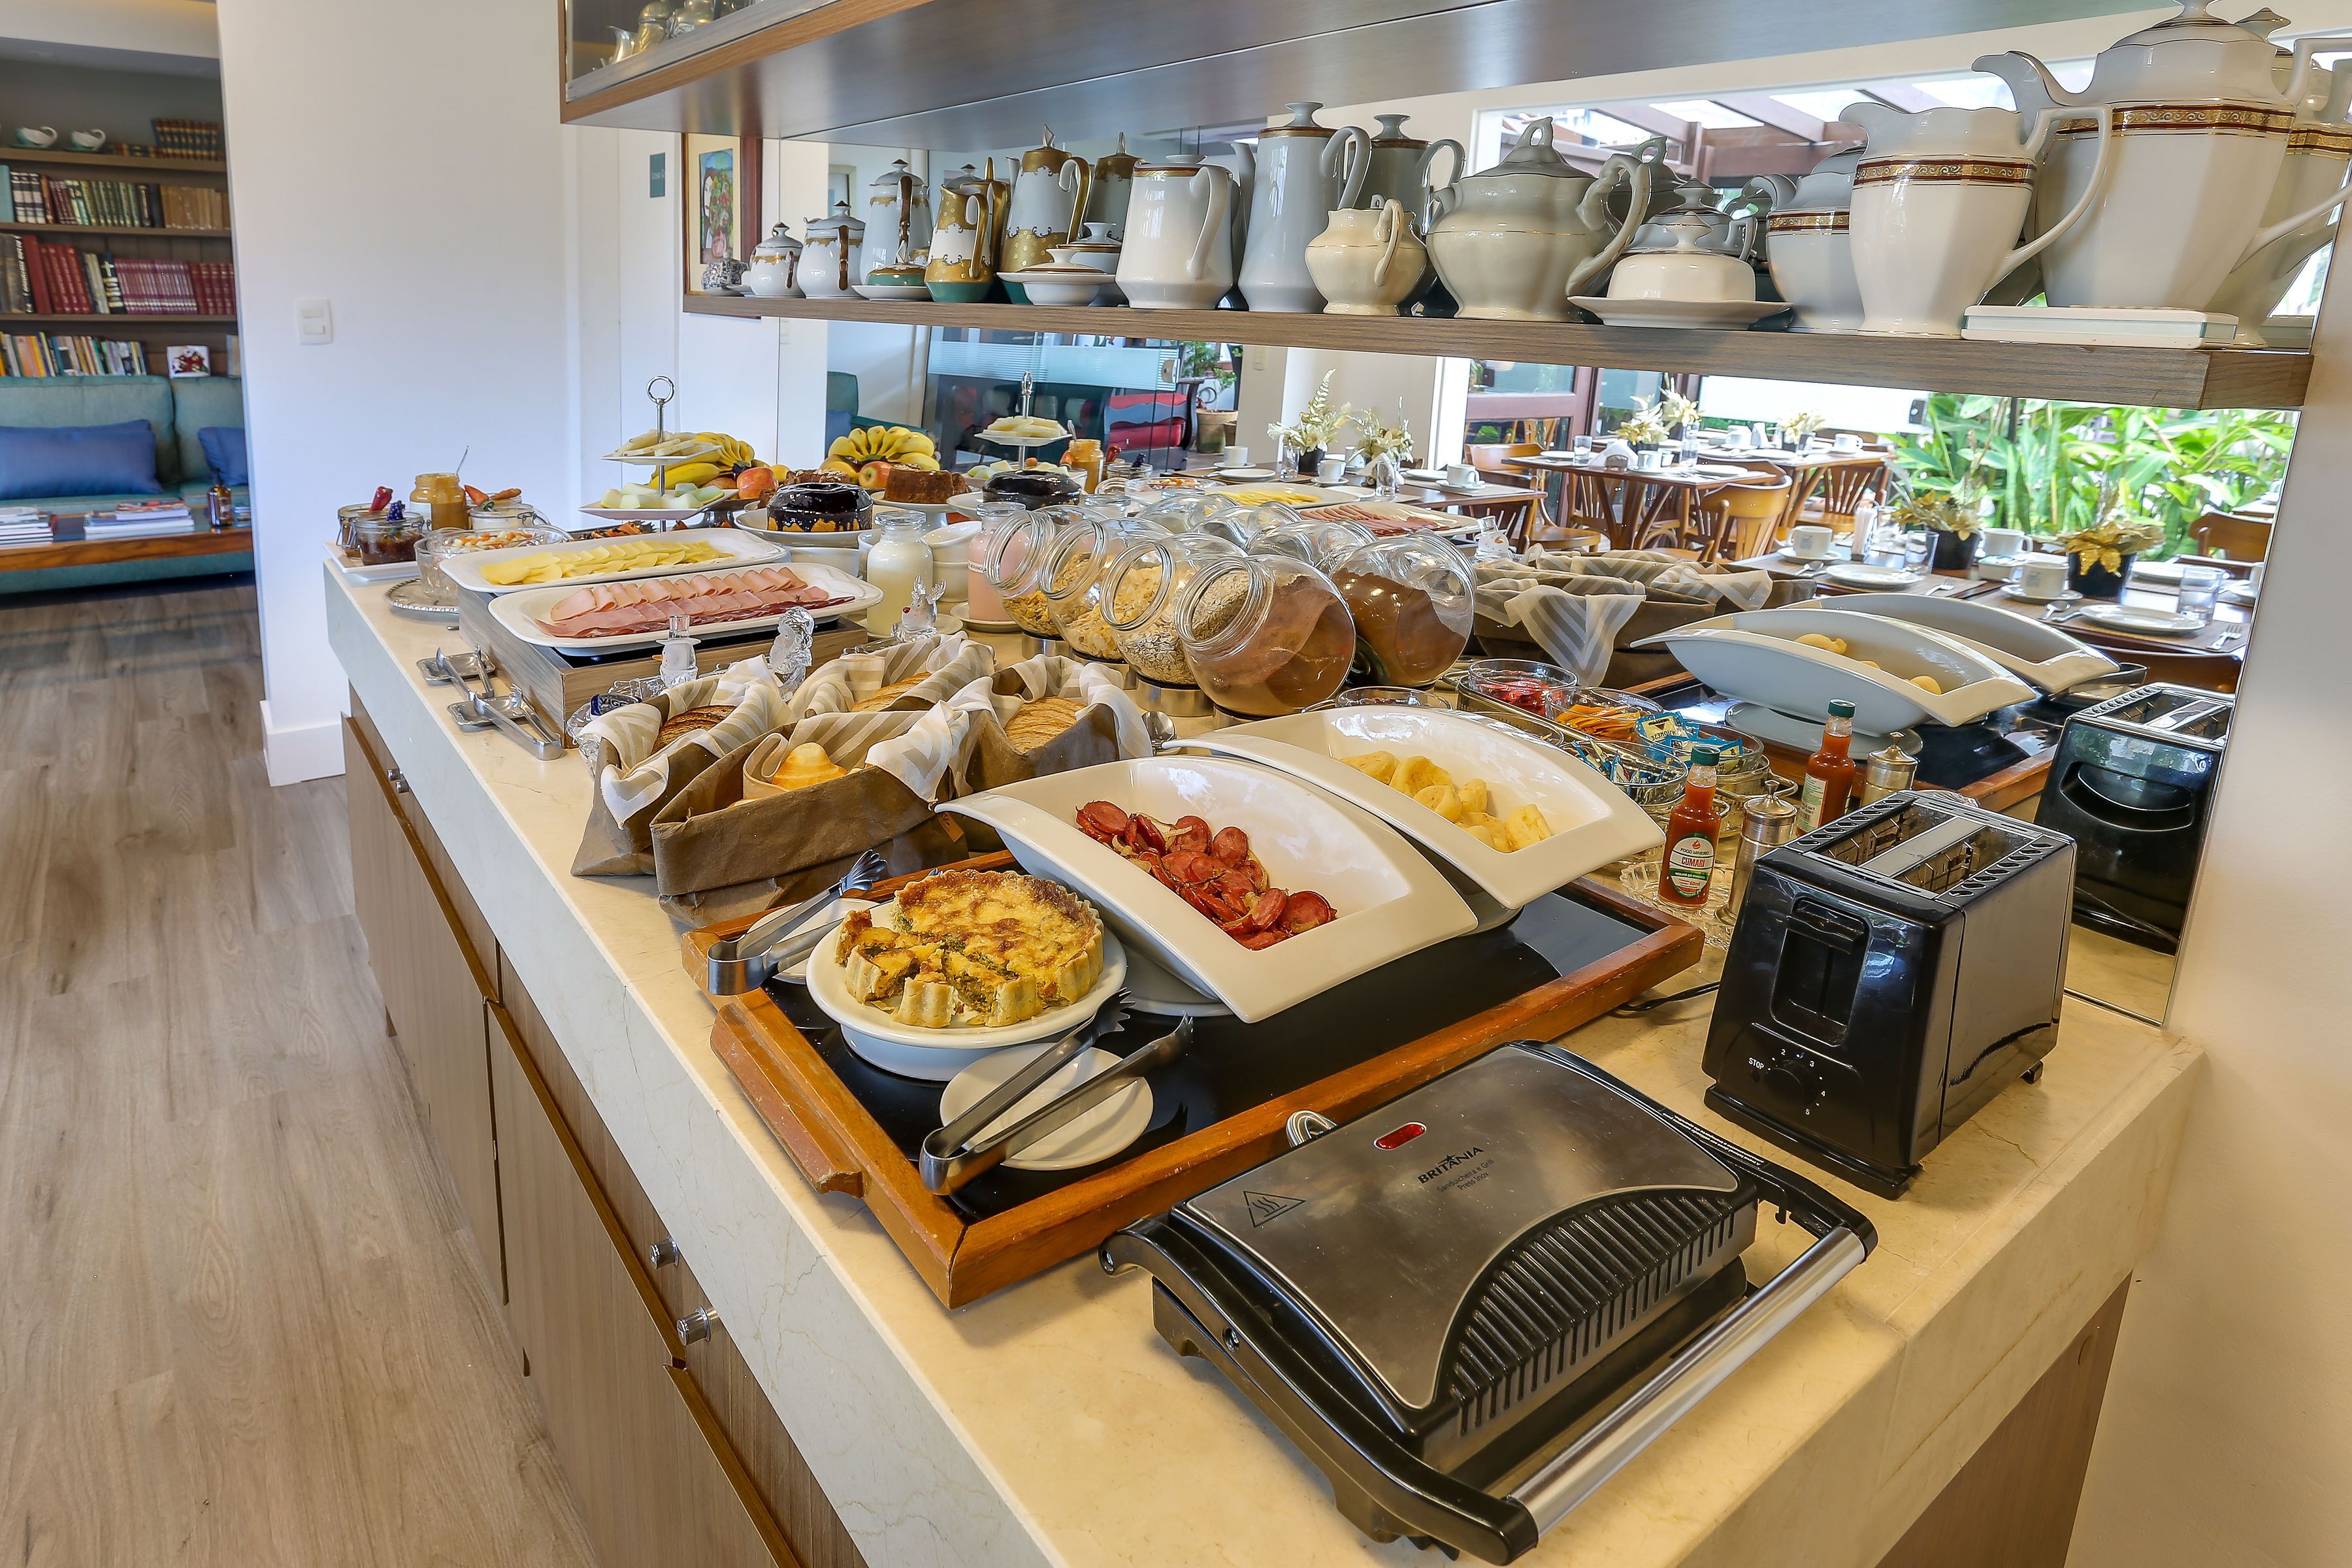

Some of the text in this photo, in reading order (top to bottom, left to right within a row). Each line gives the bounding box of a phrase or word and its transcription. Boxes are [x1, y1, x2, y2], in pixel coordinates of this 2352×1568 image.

[1682, 857, 1705, 867] CUMARI
[1748, 1057, 1764, 1070] STOP
[1437, 1169, 1477, 1192] Sanduicheira
[1480, 1158, 1495, 1169] Grill
[1457, 1172, 1490, 1190] Press Inox
